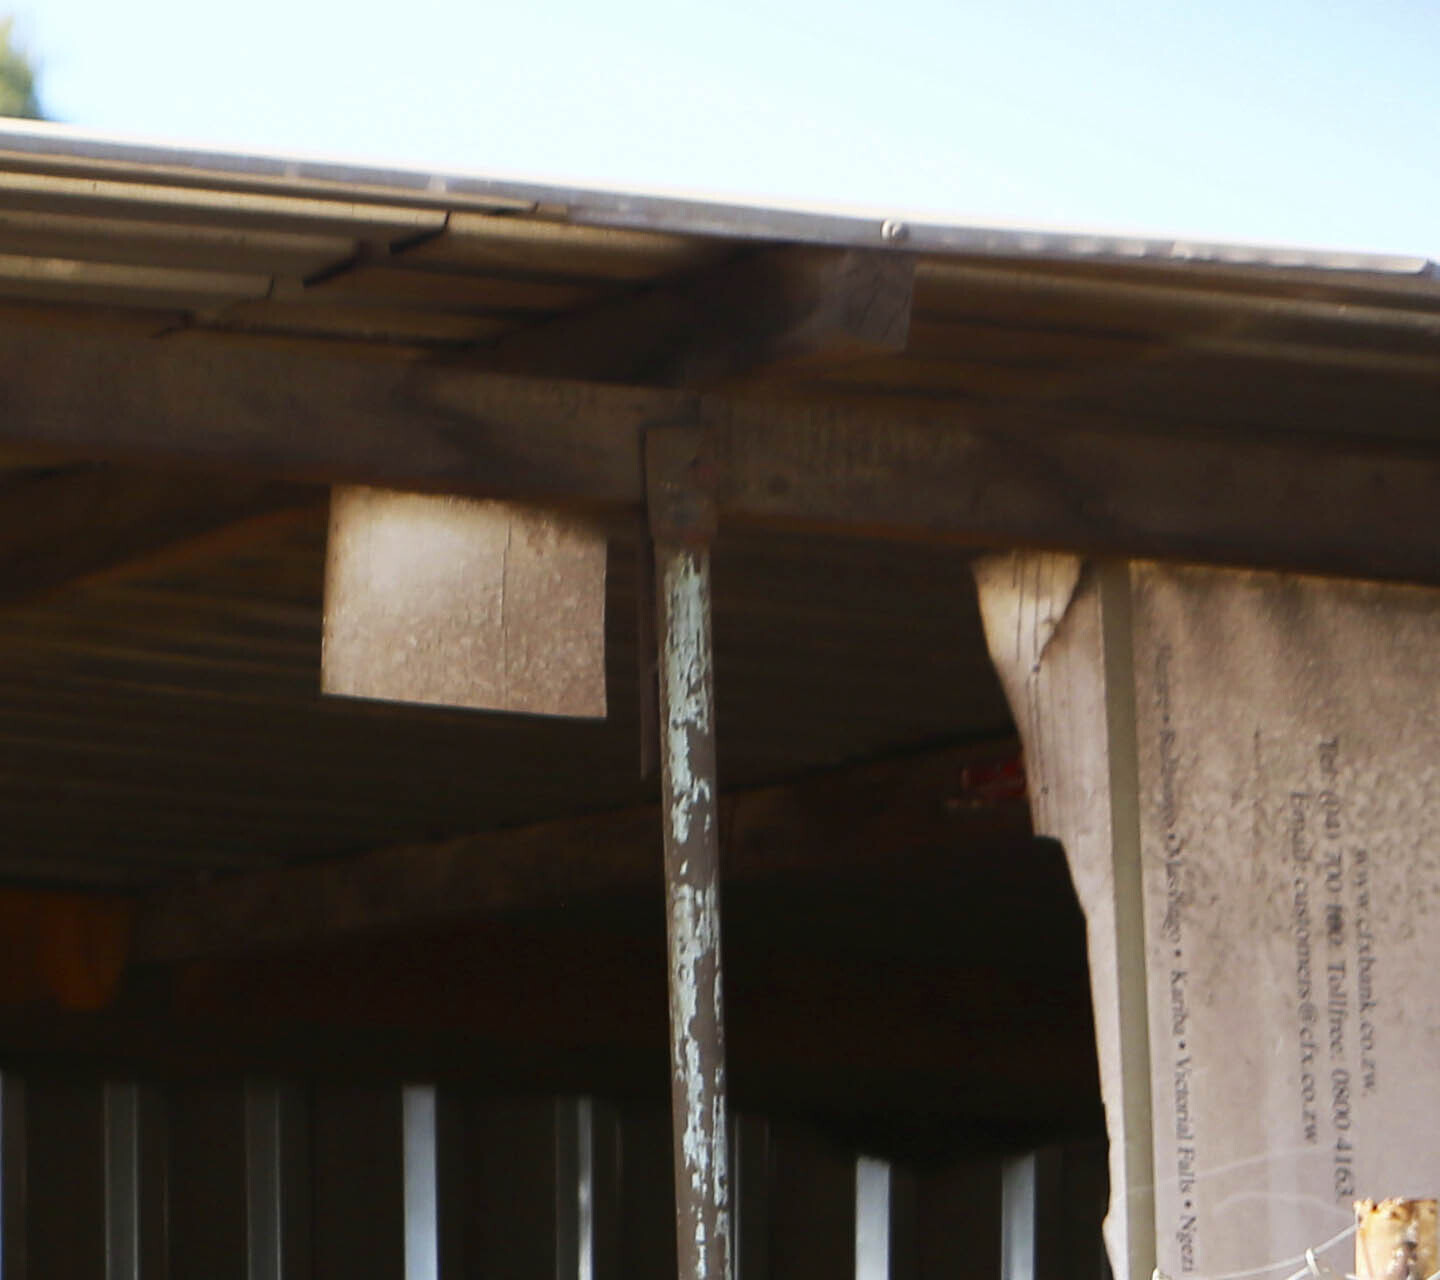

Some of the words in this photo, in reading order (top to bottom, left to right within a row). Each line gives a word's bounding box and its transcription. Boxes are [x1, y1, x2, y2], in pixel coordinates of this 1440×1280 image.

[1170, 969, 1188, 1037] Kariba
[1330, 1068, 1351, 1132] 0800
[1177, 1147, 1196, 1194] Falls
[1176, 1214, 1198, 1273] Ngezi
